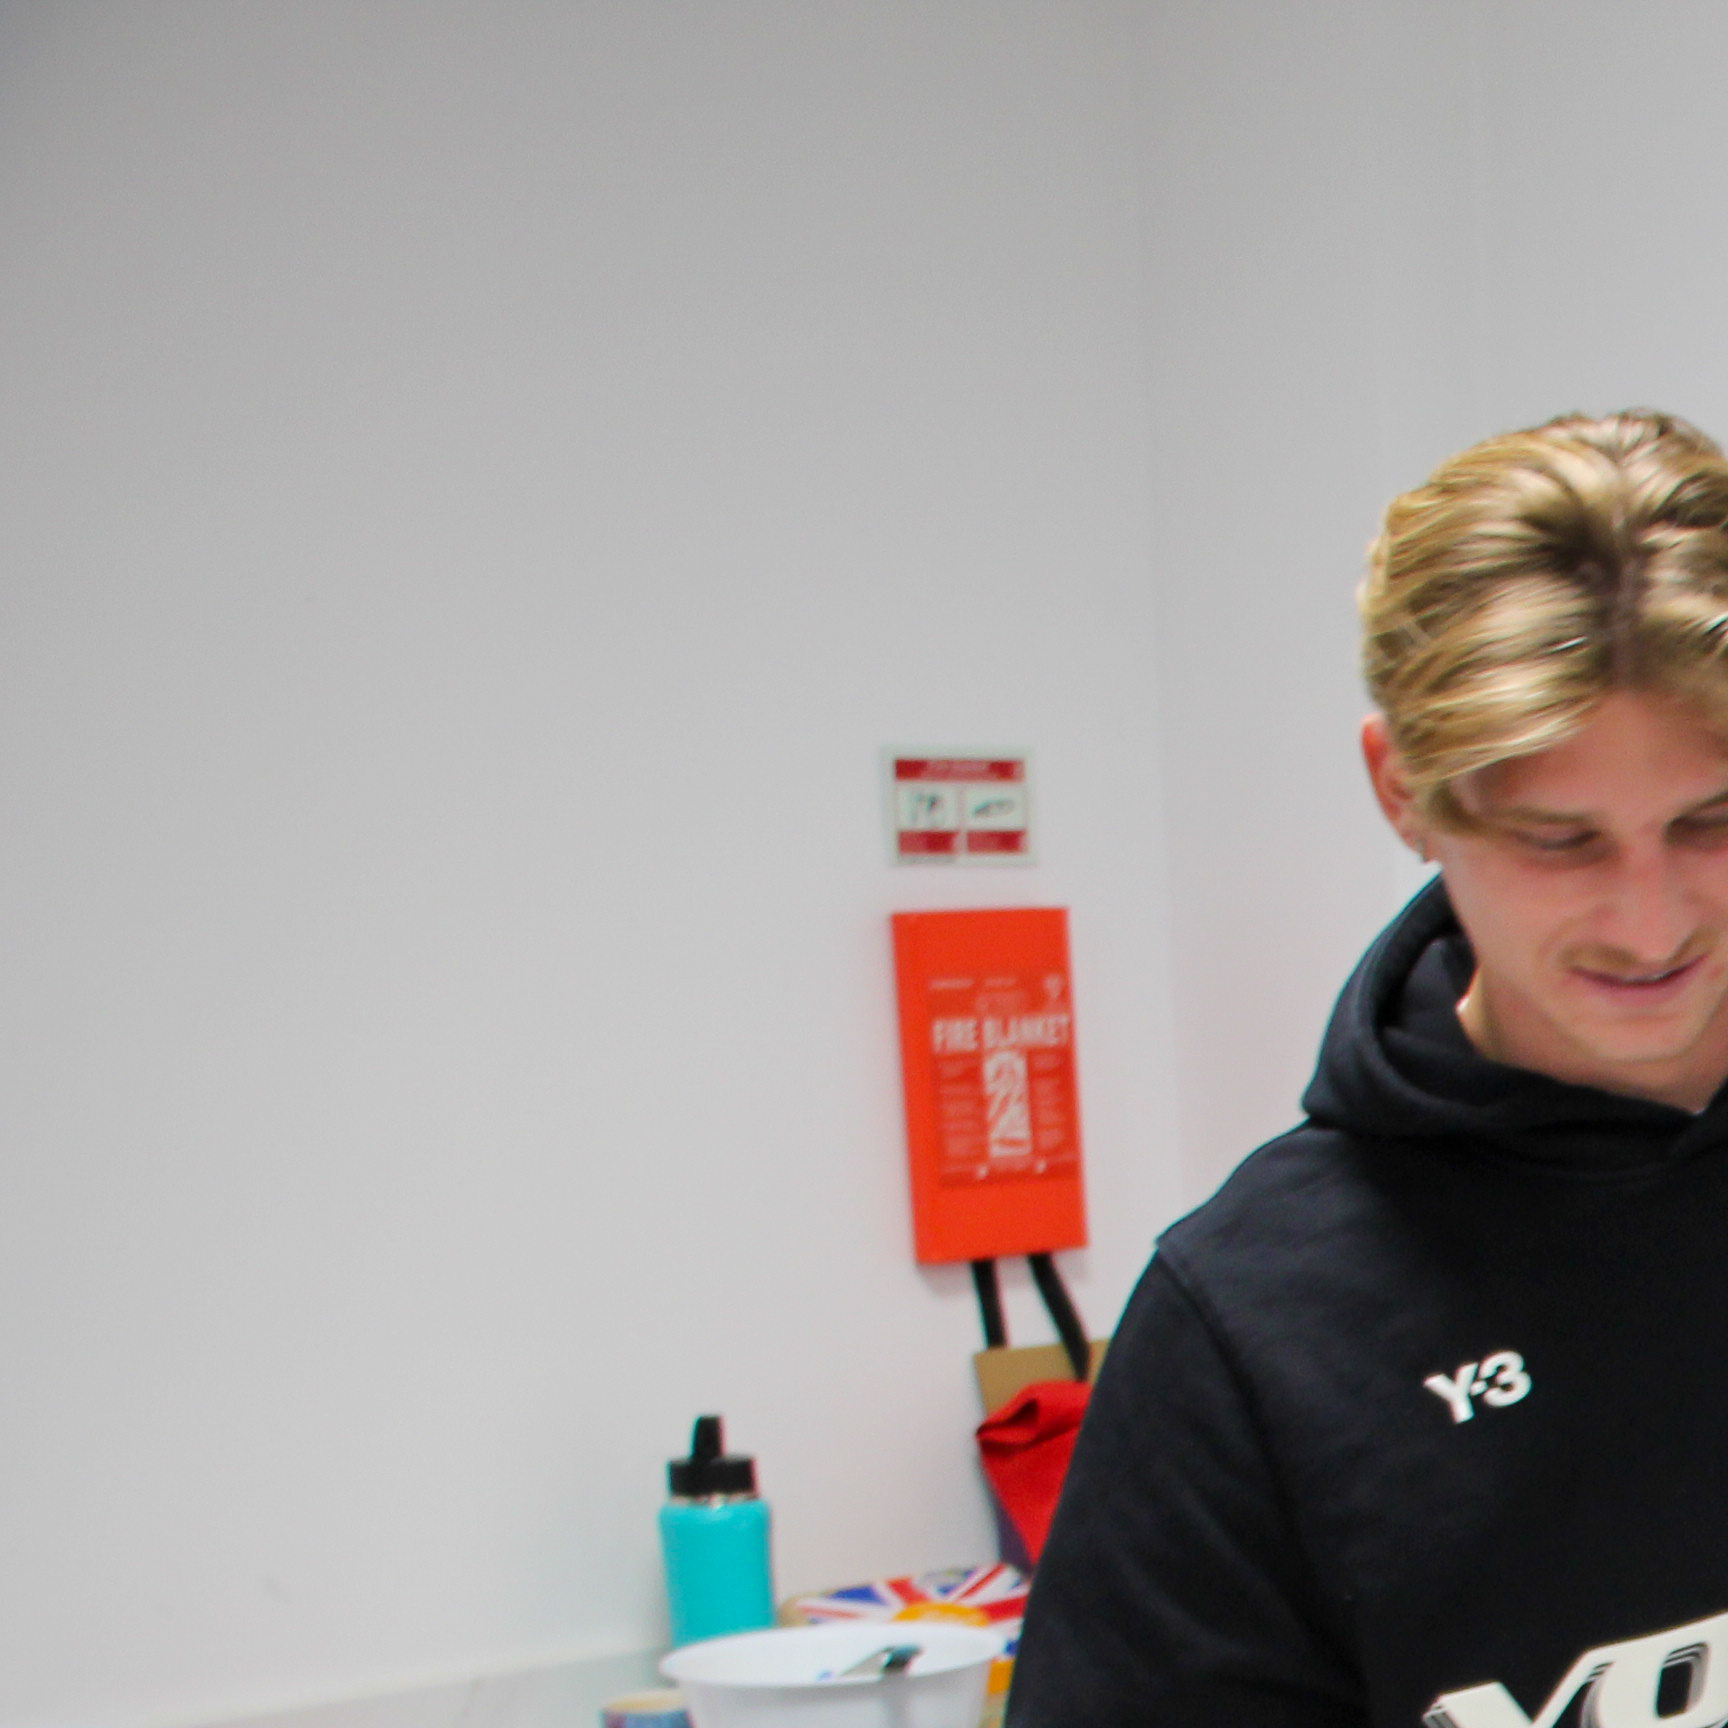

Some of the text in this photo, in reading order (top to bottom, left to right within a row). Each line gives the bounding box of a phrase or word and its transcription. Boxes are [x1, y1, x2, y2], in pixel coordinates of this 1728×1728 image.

[932, 1012, 1070, 1052] FIRE BLANKET
[1424, 1351, 1531, 1424] Y-3
